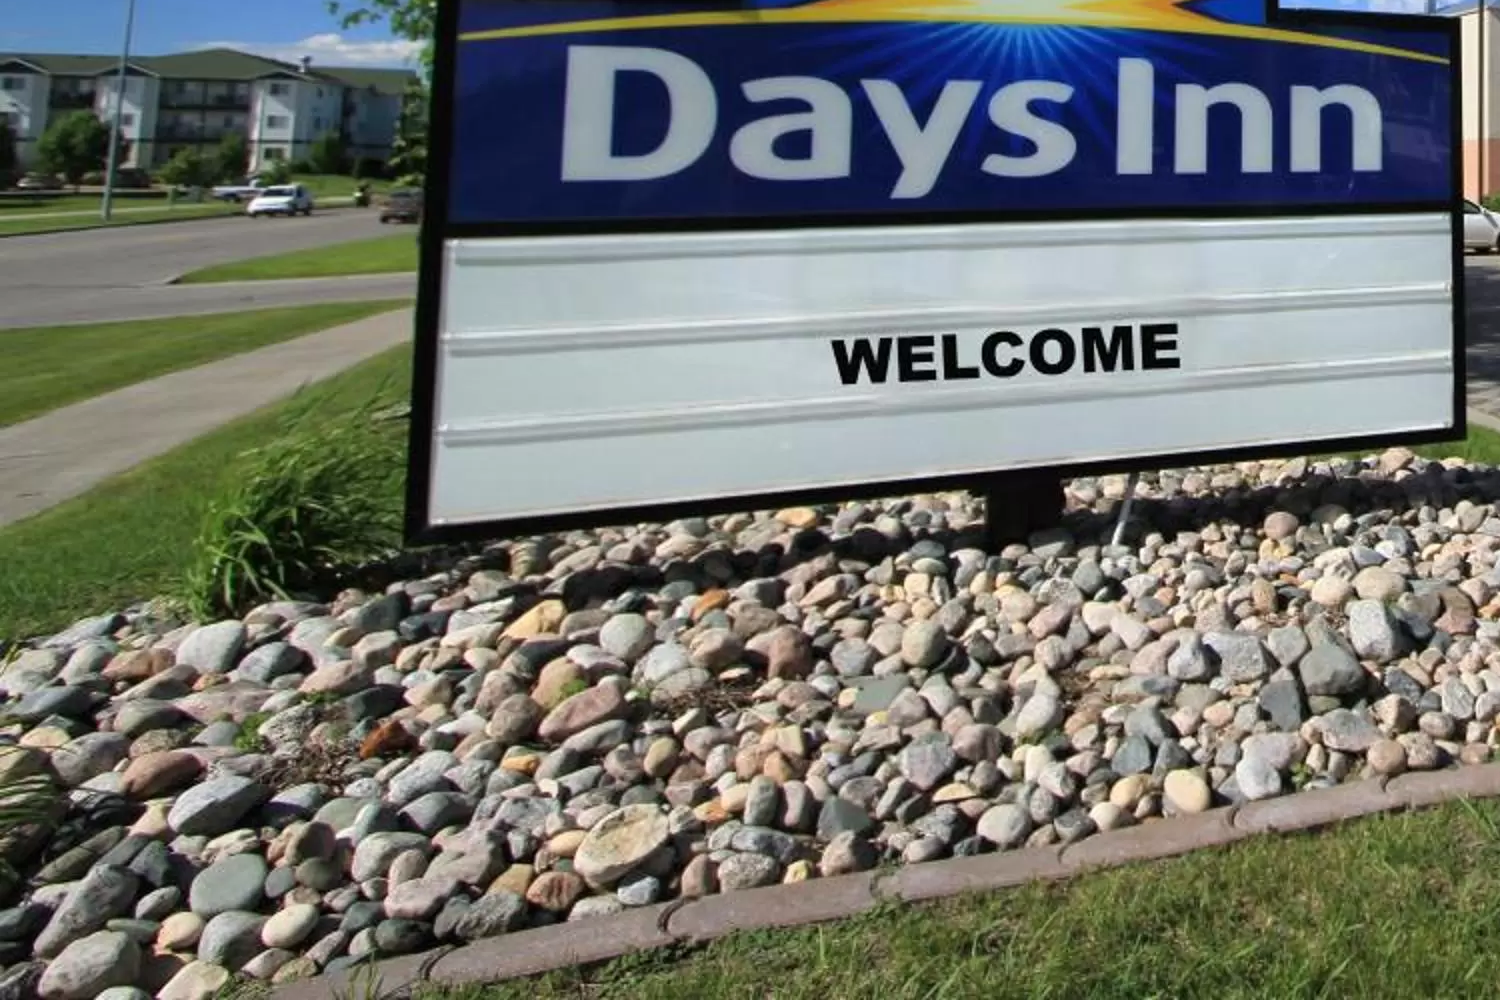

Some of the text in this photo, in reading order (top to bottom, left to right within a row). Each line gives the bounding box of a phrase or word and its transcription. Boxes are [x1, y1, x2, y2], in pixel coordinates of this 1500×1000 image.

[560, 45, 1384, 199] Days Inn
[832, 322, 1182, 386] WELCOME
